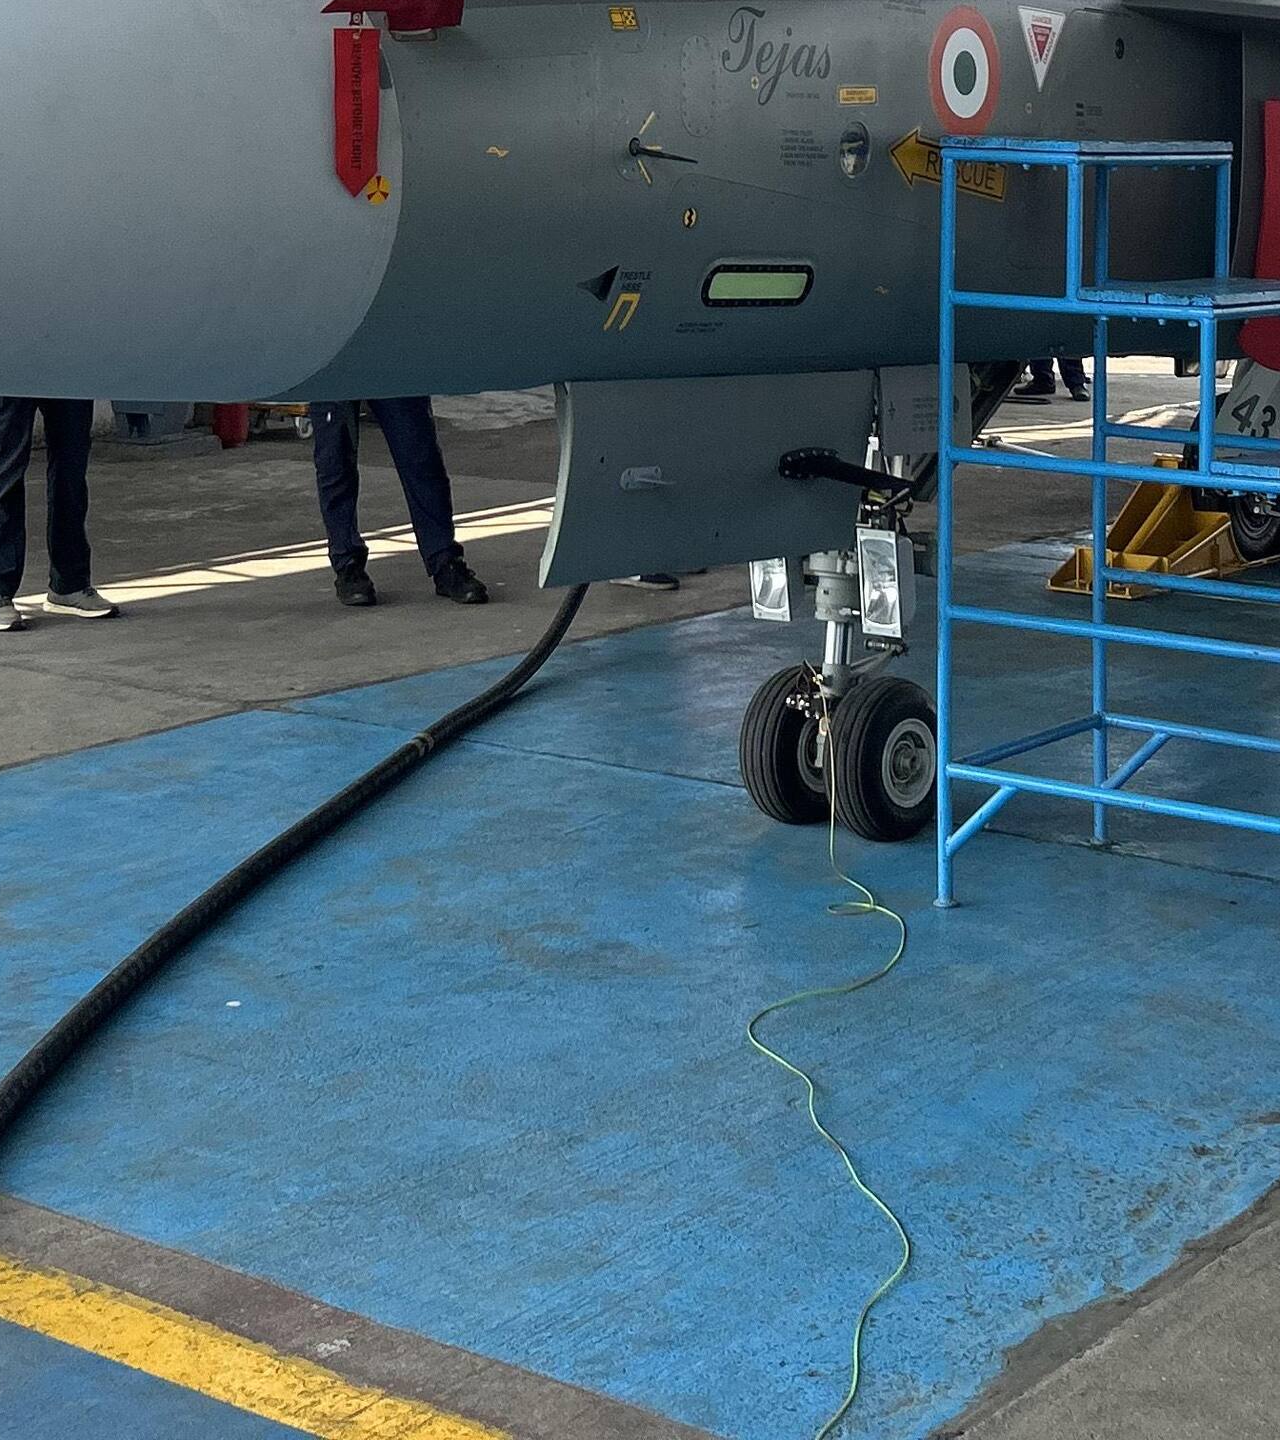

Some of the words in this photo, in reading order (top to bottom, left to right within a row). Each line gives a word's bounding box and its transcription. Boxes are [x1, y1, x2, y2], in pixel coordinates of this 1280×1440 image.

[722, 6, 831, 106] Tejas
[926, 150, 997, 191] RCUE
[620, 271, 652, 281] TRESTLE
[1232, 394, 1276, 438] 43
